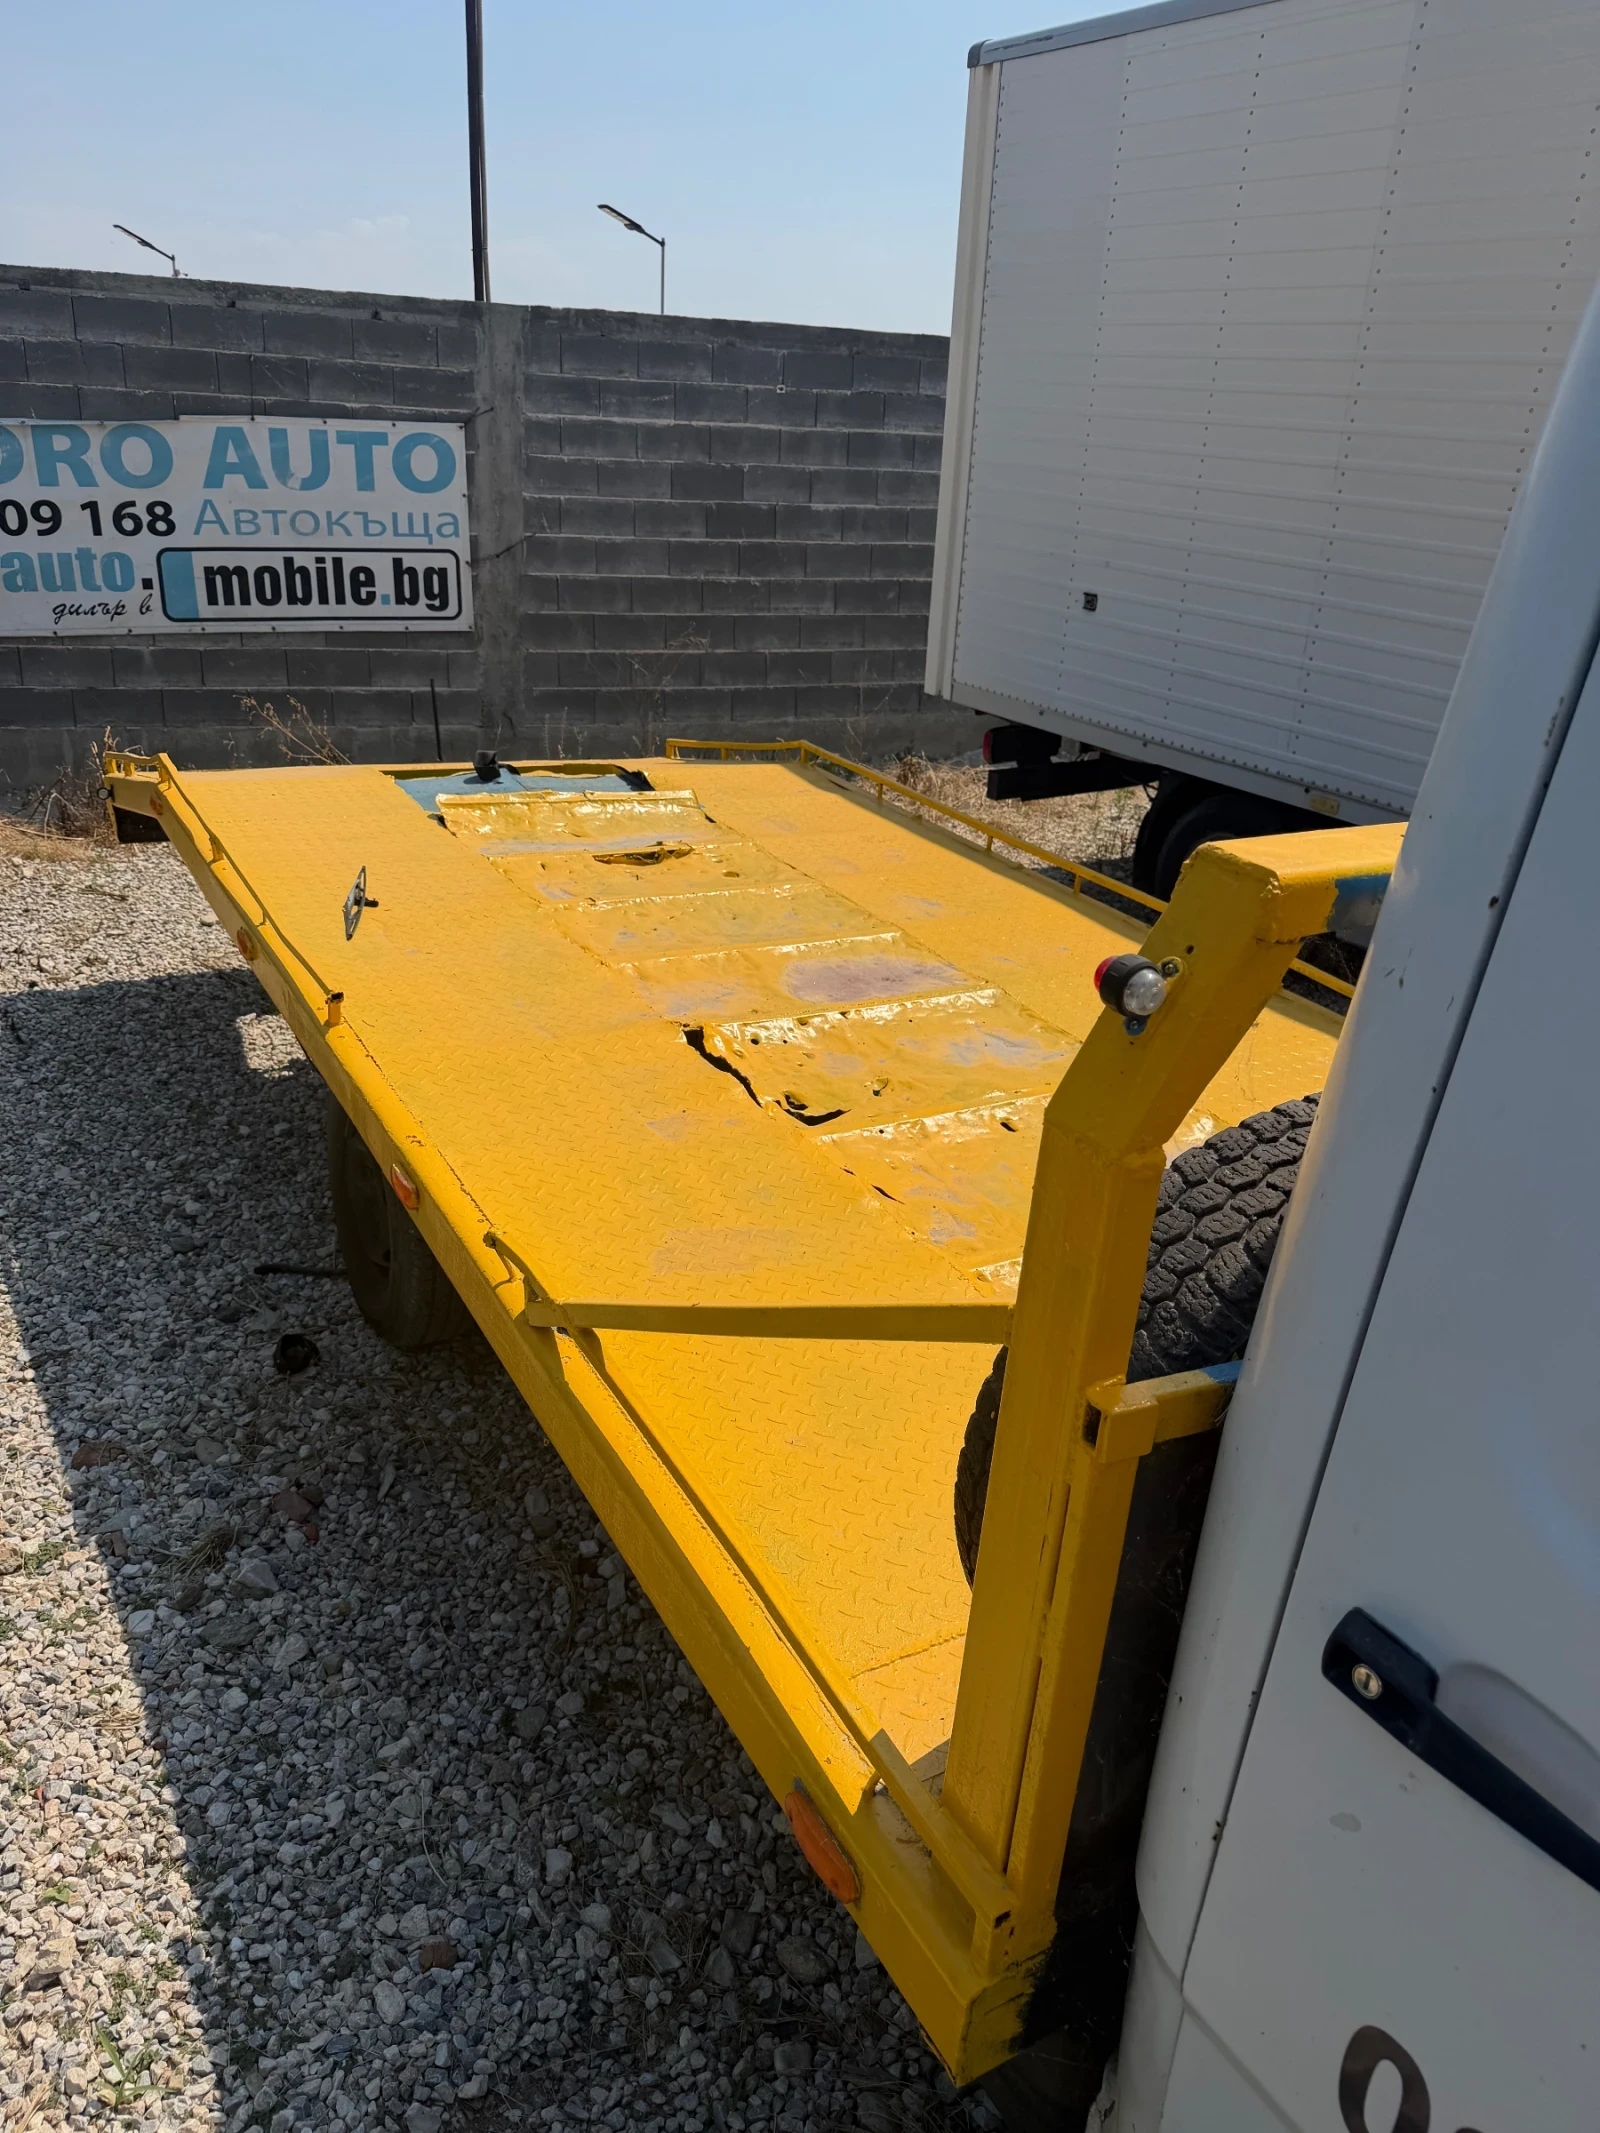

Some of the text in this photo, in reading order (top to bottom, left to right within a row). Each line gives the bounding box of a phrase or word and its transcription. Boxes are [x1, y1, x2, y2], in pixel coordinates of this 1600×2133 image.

[202, 426, 456, 494] AUTO
[0, 499, 176, 536] 09 168
[193, 499, 460, 545] Автокъща
[203, 556, 449, 612] mobile.bg
[52, 599, 127, 625] дилър
